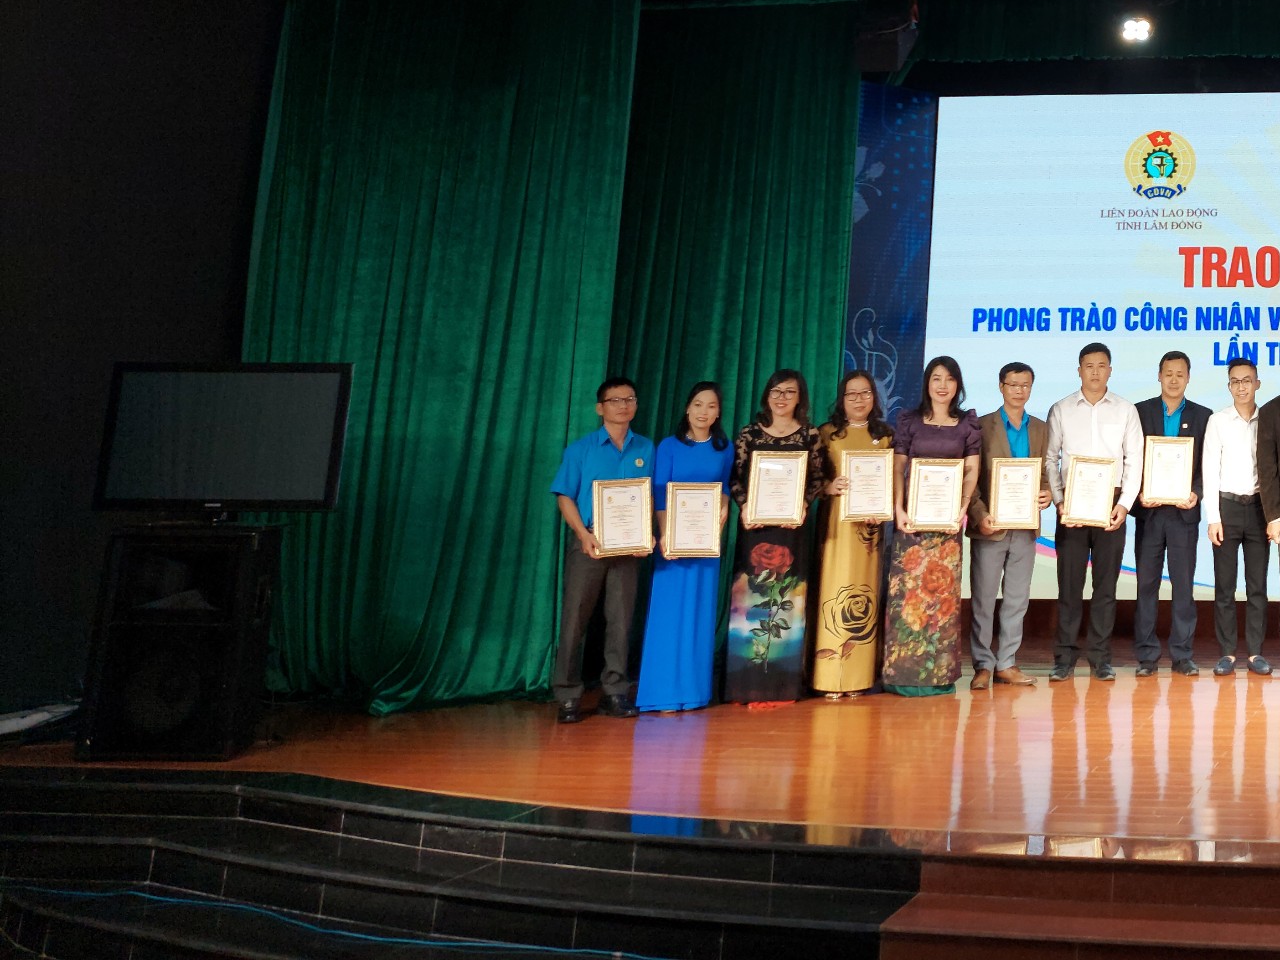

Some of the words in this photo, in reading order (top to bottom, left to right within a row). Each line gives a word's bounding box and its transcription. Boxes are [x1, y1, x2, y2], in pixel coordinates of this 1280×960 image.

[1162, 208, 1185, 218] LAO
[1179, 245, 1280, 288] TRAO
[972, 307, 1051, 332] PHONG
[1058, 302, 1117, 332] TRÀO
[1124, 301, 1188, 332] CÔNG
[1195, 301, 1260, 331] NHÂN
[1213, 333, 1259, 366] LẦN
